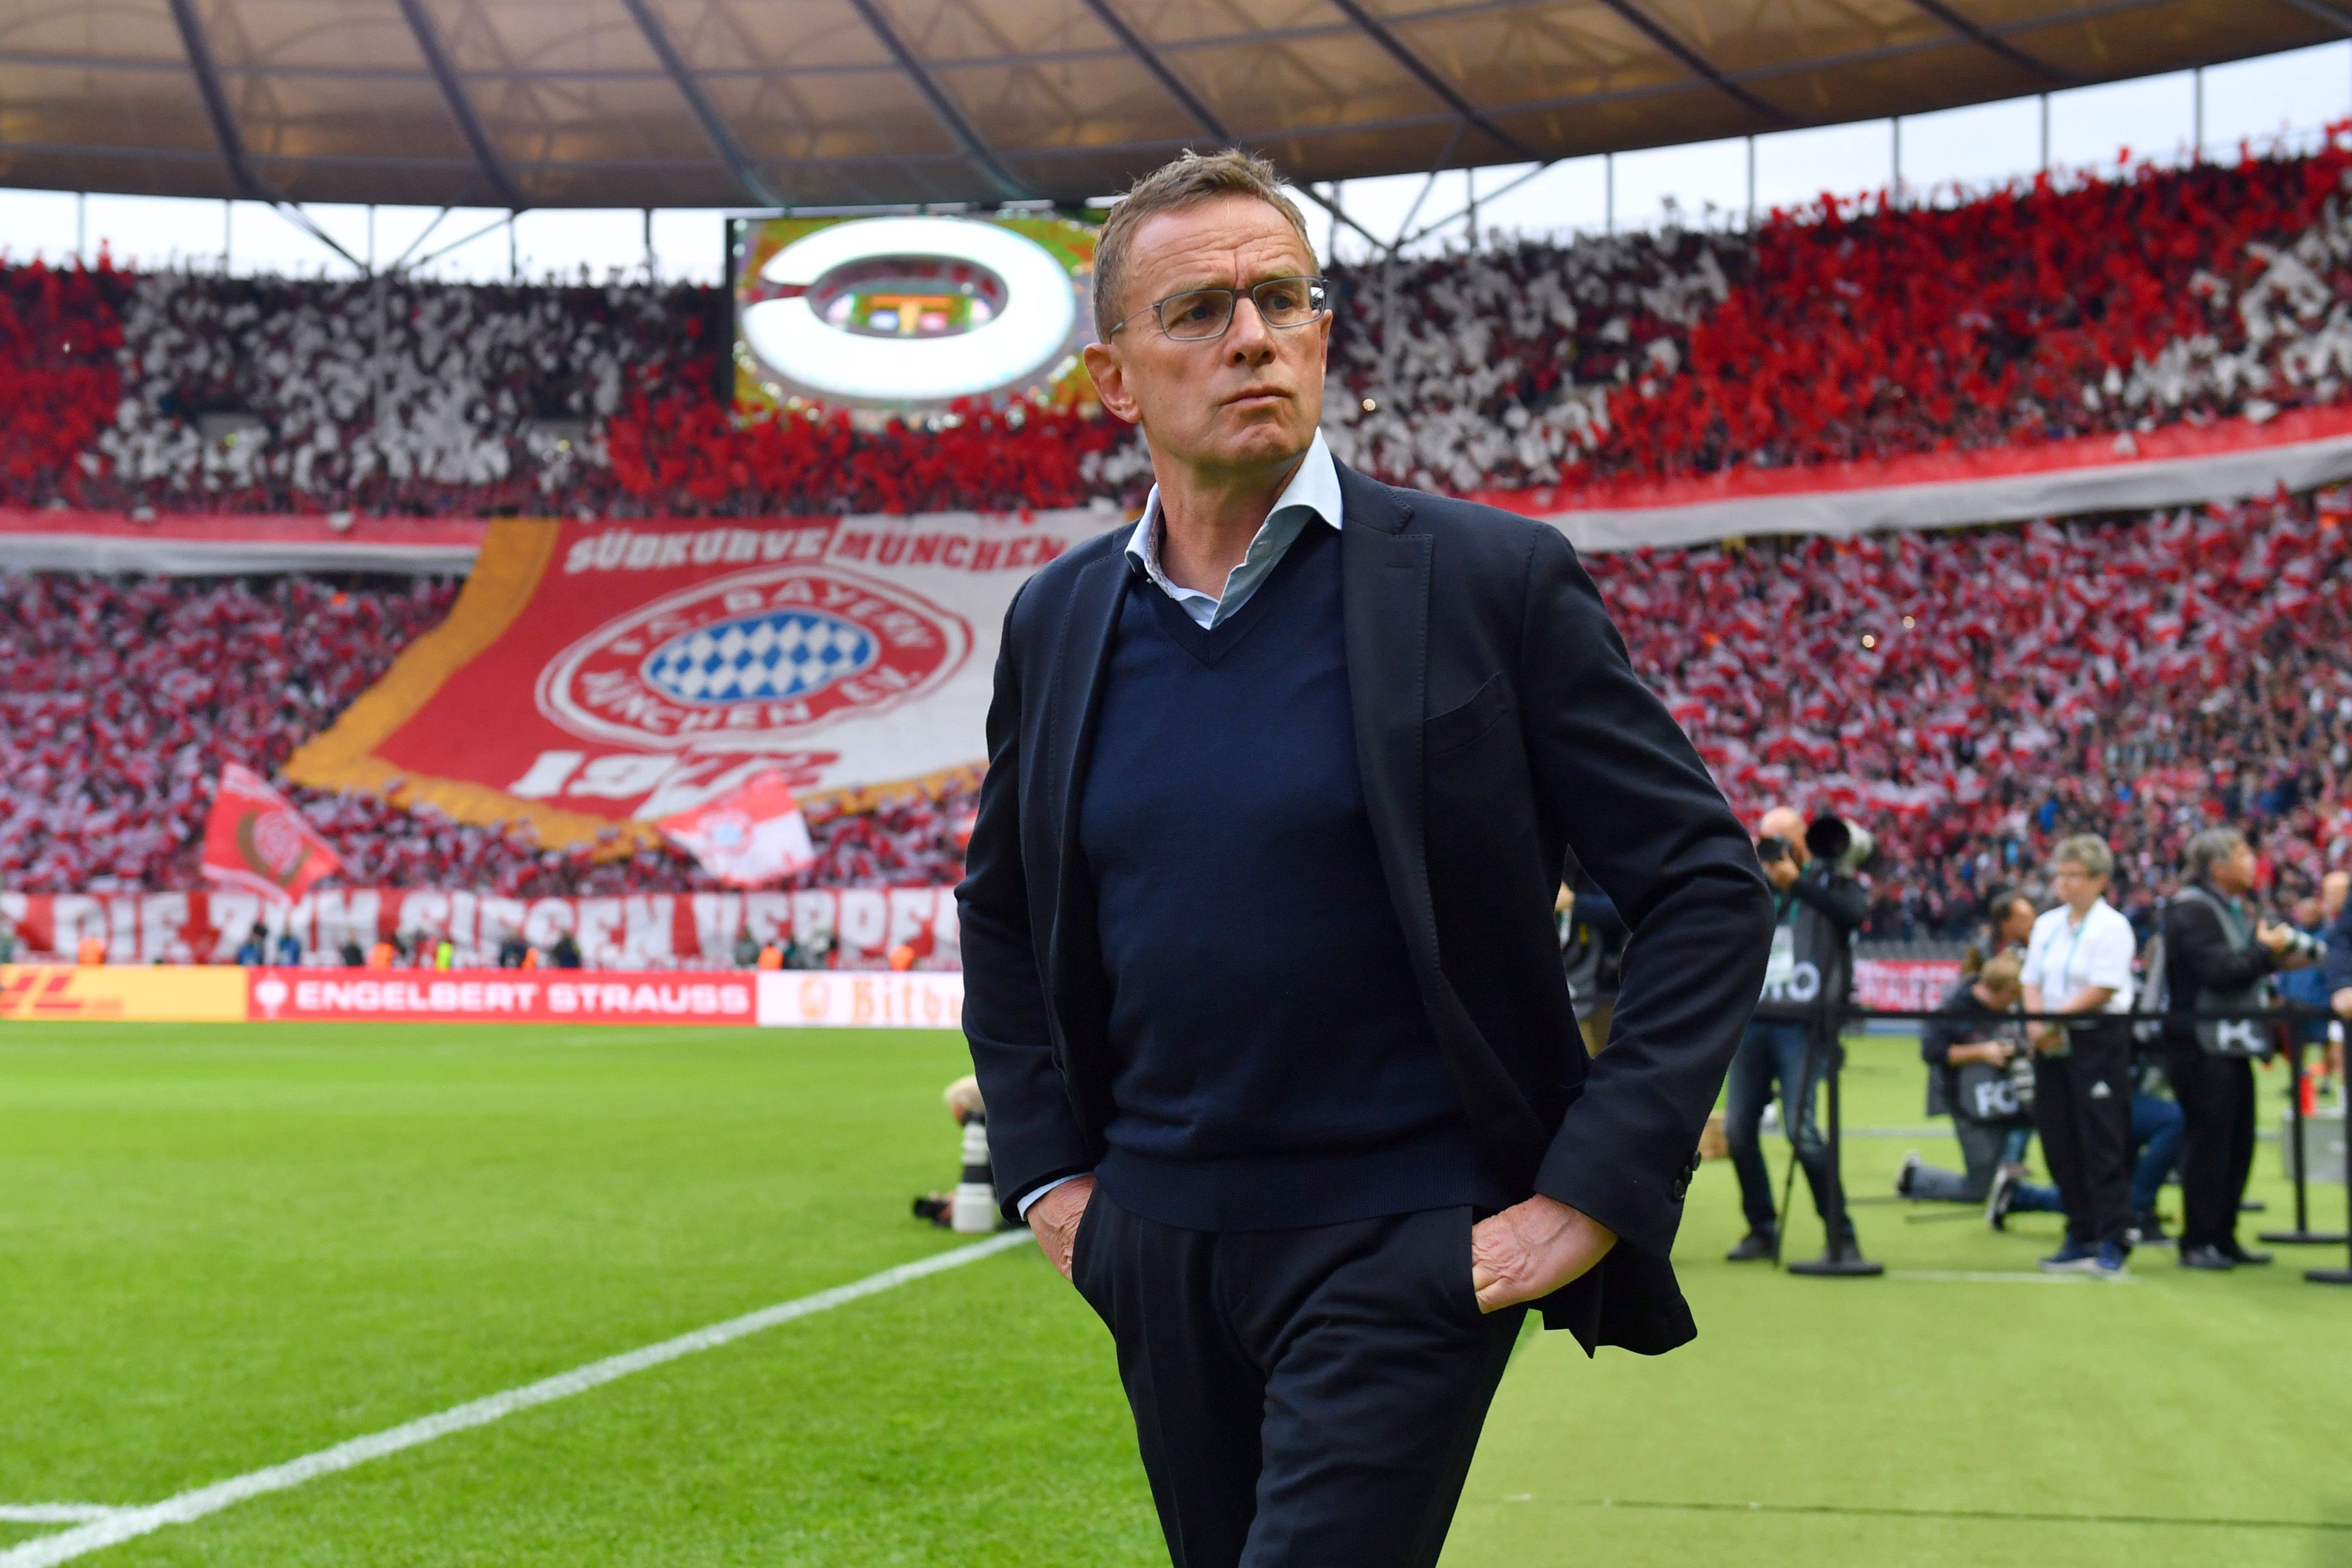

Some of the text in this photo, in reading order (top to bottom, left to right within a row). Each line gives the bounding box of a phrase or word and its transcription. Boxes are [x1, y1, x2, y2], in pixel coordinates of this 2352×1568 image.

[564, 529, 827, 573] SÜDKURVE
[296, 981, 750, 1014] ENGELBERT STRAUSS
